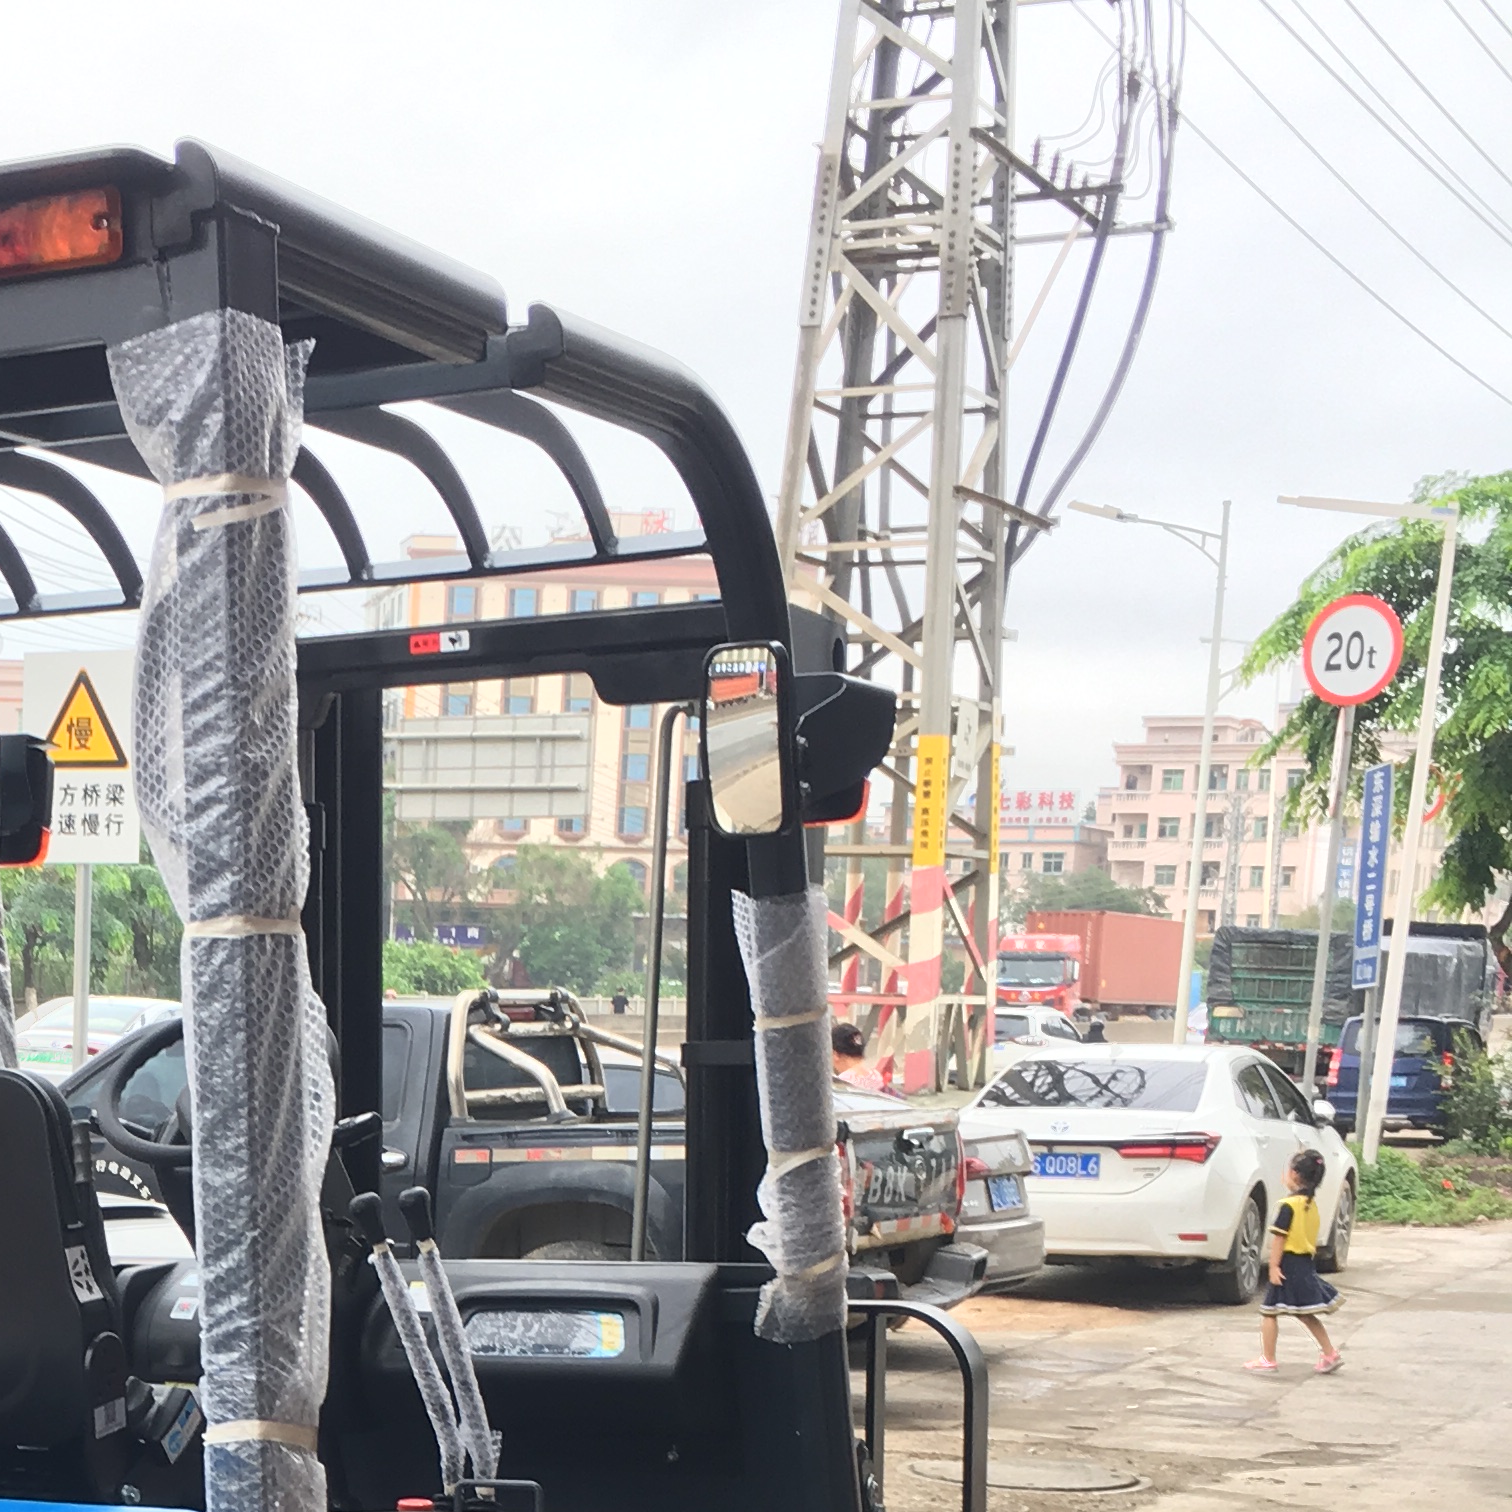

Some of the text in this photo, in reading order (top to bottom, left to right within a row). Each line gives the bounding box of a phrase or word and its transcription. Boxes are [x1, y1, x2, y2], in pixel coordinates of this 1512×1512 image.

[1324, 629, 1378, 673] 20t
[66, 715, 93, 751] 慢
[58, 782, 125, 807] 方桥梁
[57, 812, 125, 837] 速慢行
